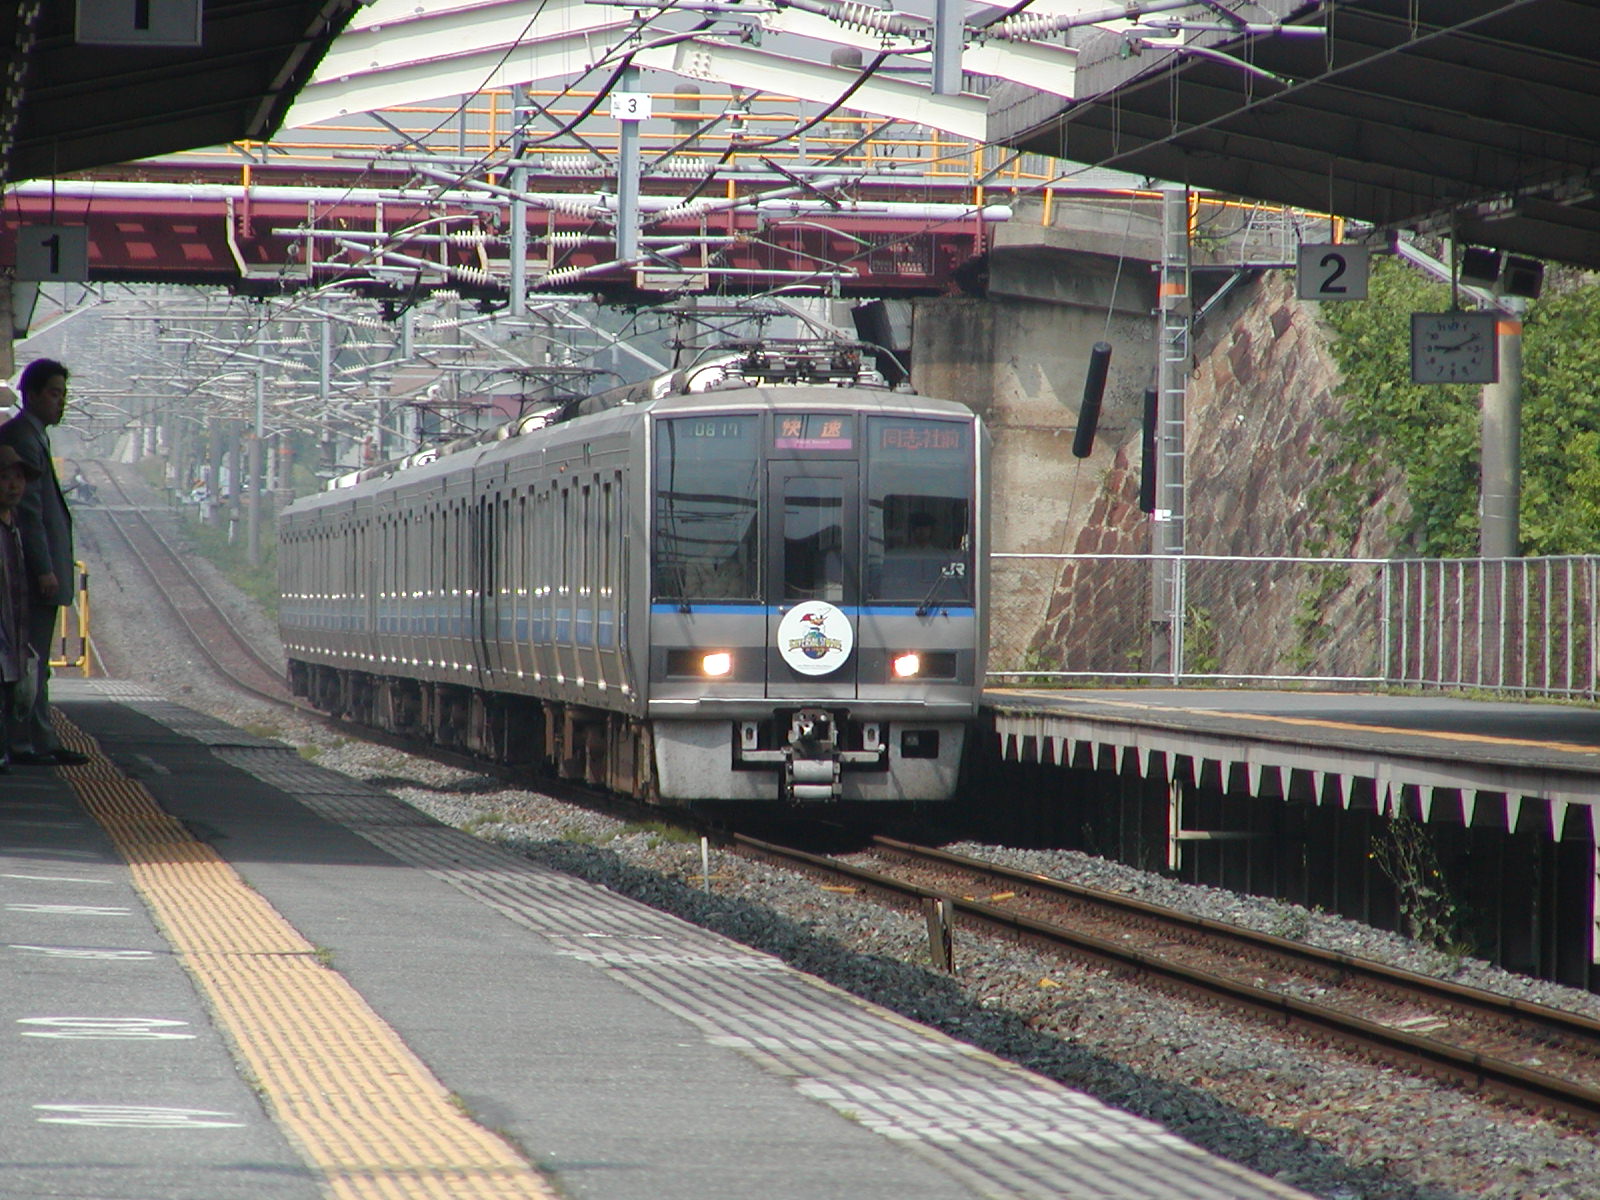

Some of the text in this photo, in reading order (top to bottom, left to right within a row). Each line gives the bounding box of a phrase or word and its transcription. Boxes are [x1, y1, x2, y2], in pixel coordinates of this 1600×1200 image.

[628, 98, 637, 113] 3
[41, 233, 59, 274] 1
[1319, 252, 1346, 293] 2
[942, 562, 965, 576] JR
